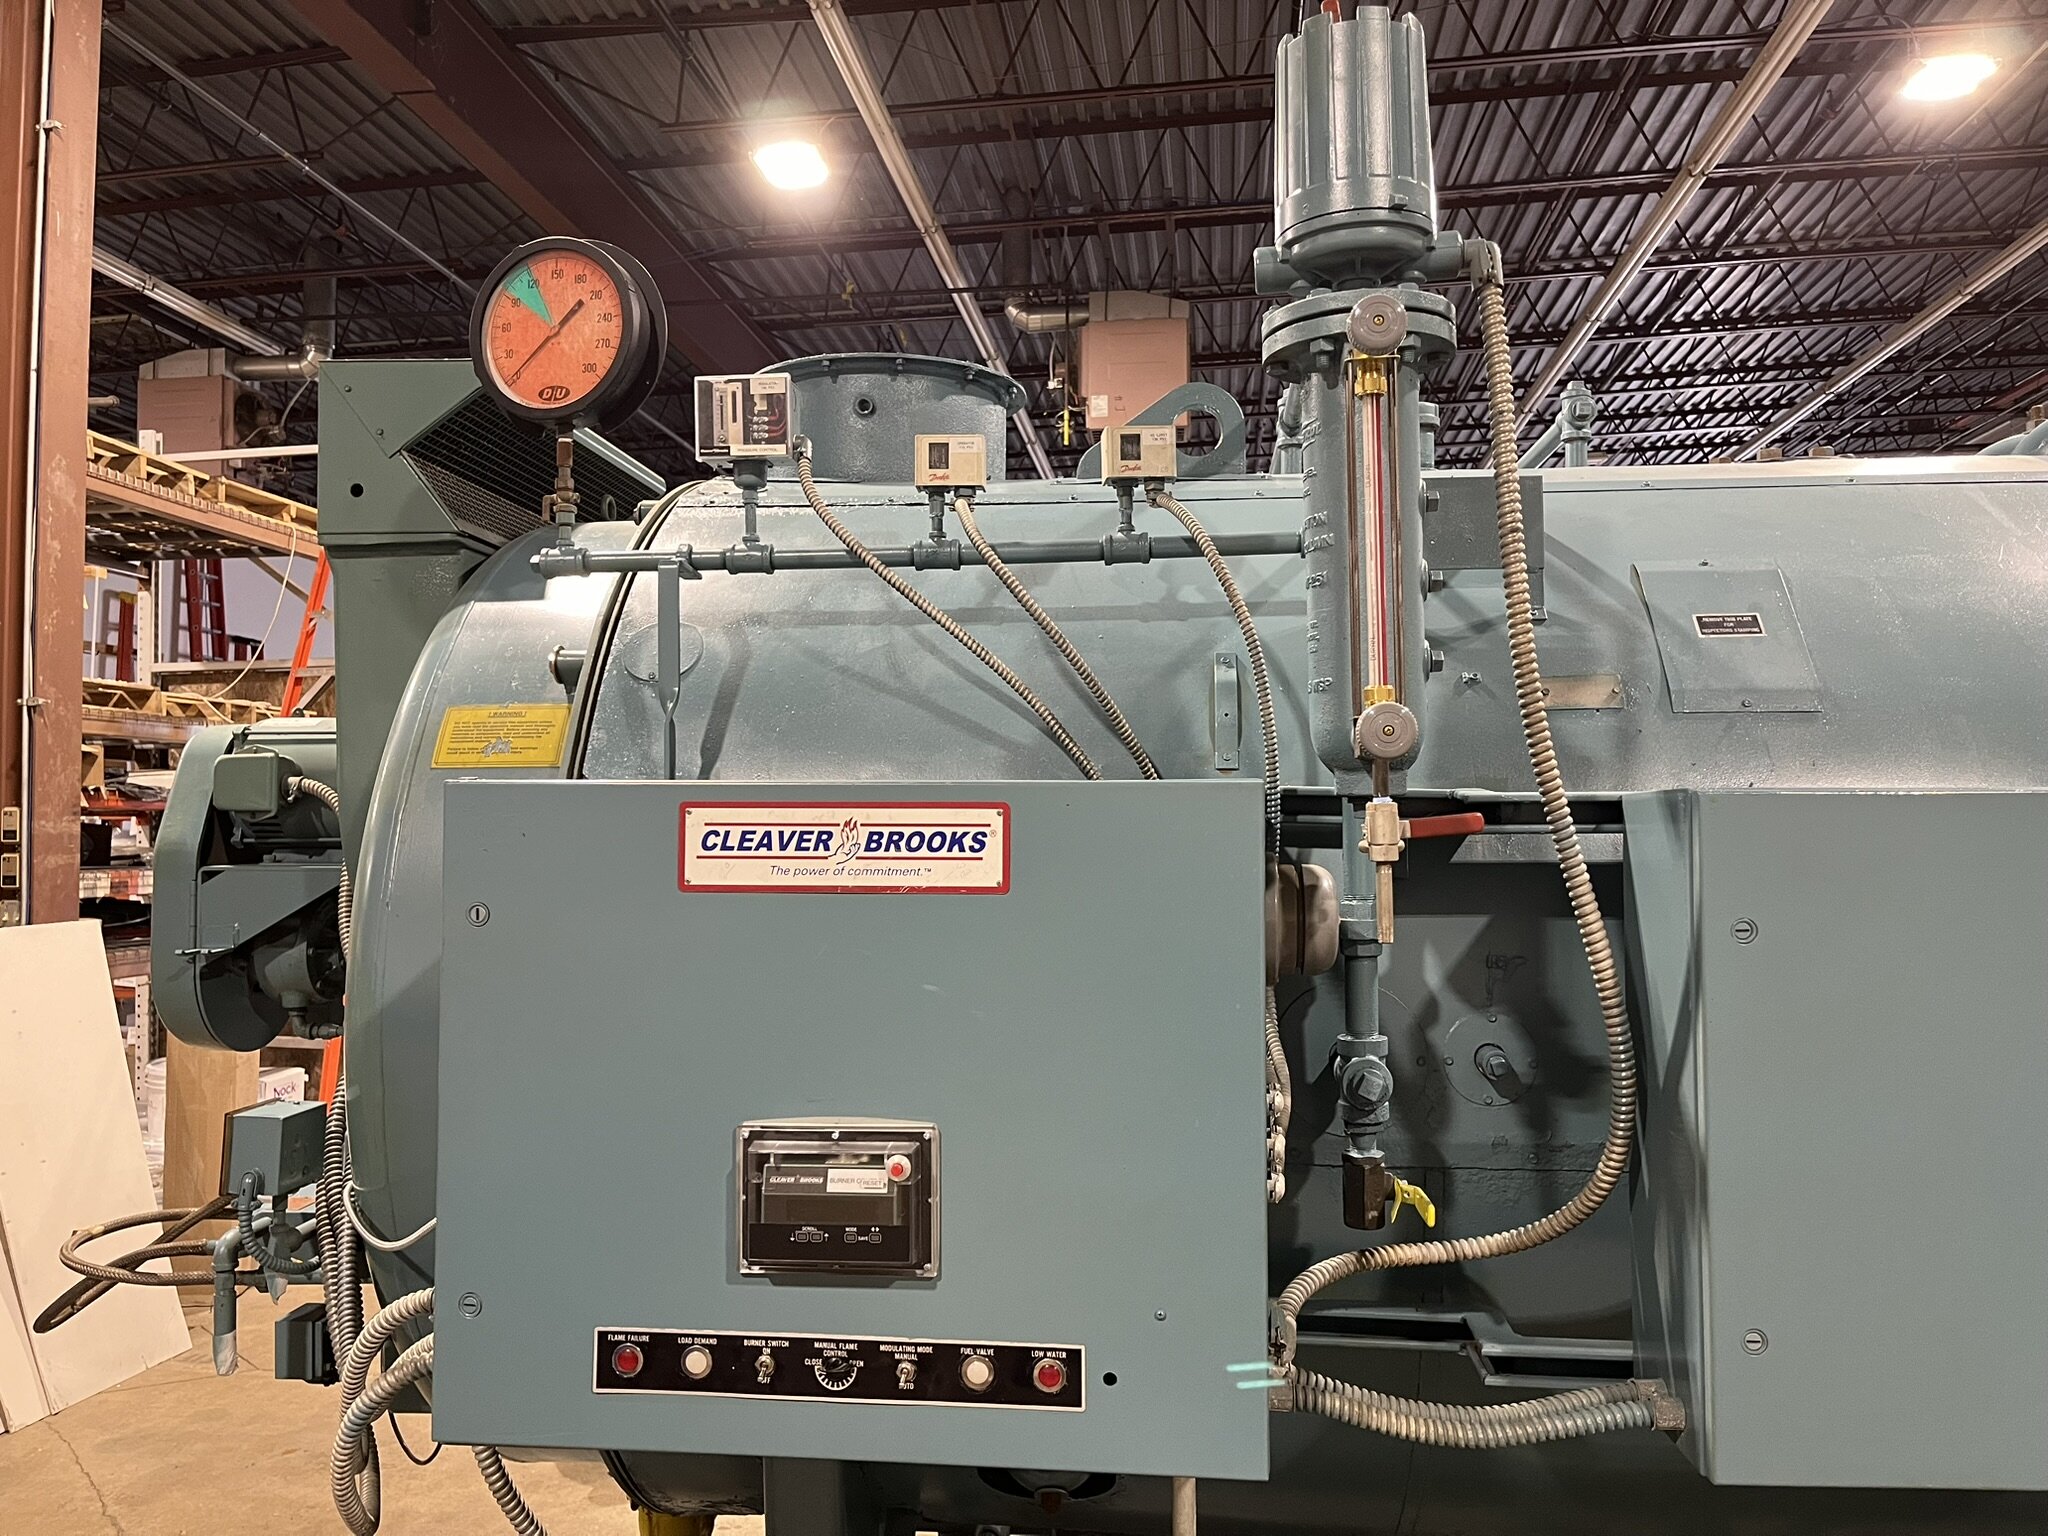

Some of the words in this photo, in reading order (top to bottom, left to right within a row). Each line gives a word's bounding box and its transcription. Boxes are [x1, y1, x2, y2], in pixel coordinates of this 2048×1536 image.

[551, 269, 564, 280] 150
[574, 273, 587, 284] 180
[527, 278, 540, 289] 120
[589, 290, 603, 300] 210
[511, 297, 521, 308] 90
[597, 313, 612, 323] 240
[501, 322, 512, 333] 60
[595, 338, 610, 349] 270
[503, 349, 514, 359] 30
[581, 363, 597, 374] 300
[701, 830, 834, 852] CLEAVER
[770, 866, 788, 876] The
[794, 867, 830, 878] power
[833, 866, 845, 876] of
[770, 1176, 796, 1184] CLEAVER
[744, 1339, 766, 1347] BURNER
[768, 1340, 790, 1348] SWITCH
[814, 1342, 837, 1350] MANUAL
[838, 1342, 858, 1350] FLAME
[880, 1344, 916, 1352] MODULATING
[823, 1350, 848, 1358] CONTROL
[894, 1353, 918, 1361] MANUAL
[976, 1348, 994, 1356] VALVE
[804, 1358, 822, 1366] CLOSE
